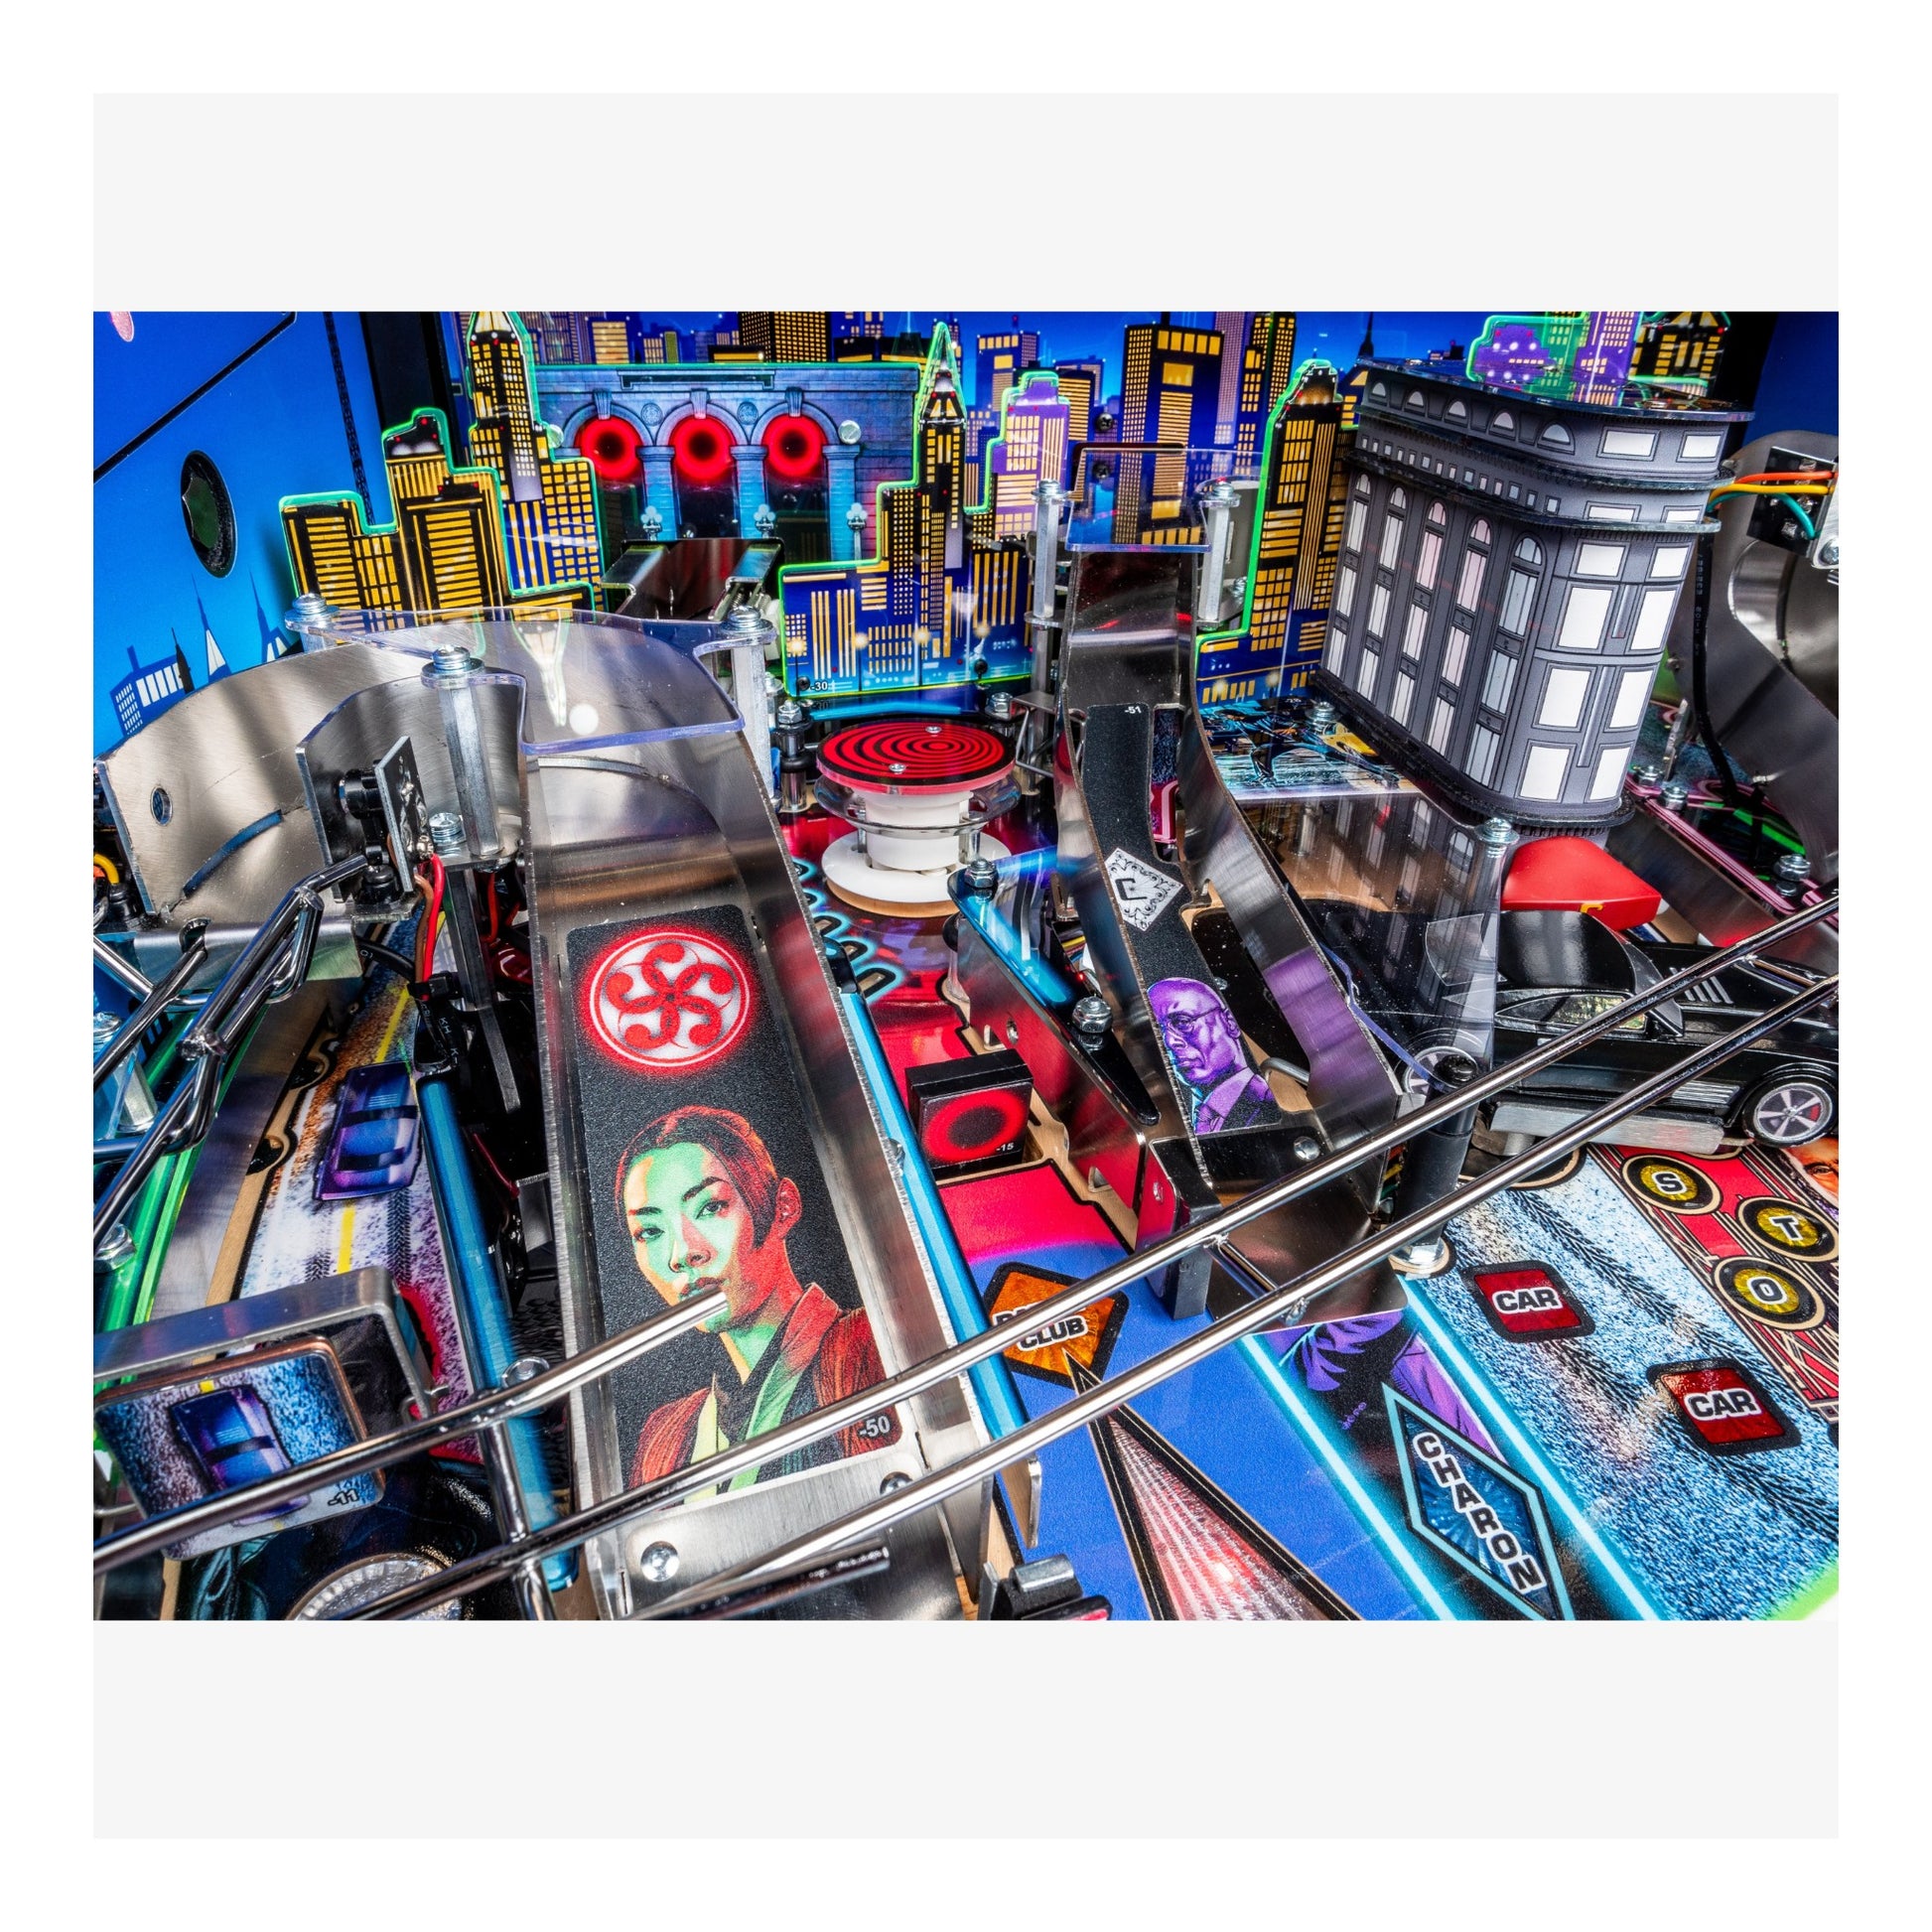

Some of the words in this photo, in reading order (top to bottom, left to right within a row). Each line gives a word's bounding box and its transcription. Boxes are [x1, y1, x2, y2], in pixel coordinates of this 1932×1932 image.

[810, 681, 828, 691] -30
[996, 1142, 1015, 1152] -15
[1653, 1172, 1686, 1194] S
[1770, 1215, 1803, 1241] T
[1493, 1287, 1562, 1313] CAR
[1018, 1316, 1087, 1350] CLUB
[1685, 1389, 1760, 1420] CAR
[859, 1416, 891, 1438] -50
[328, 1488, 359, 1505] -11
[1414, 1433, 1546, 1592] CHARON
